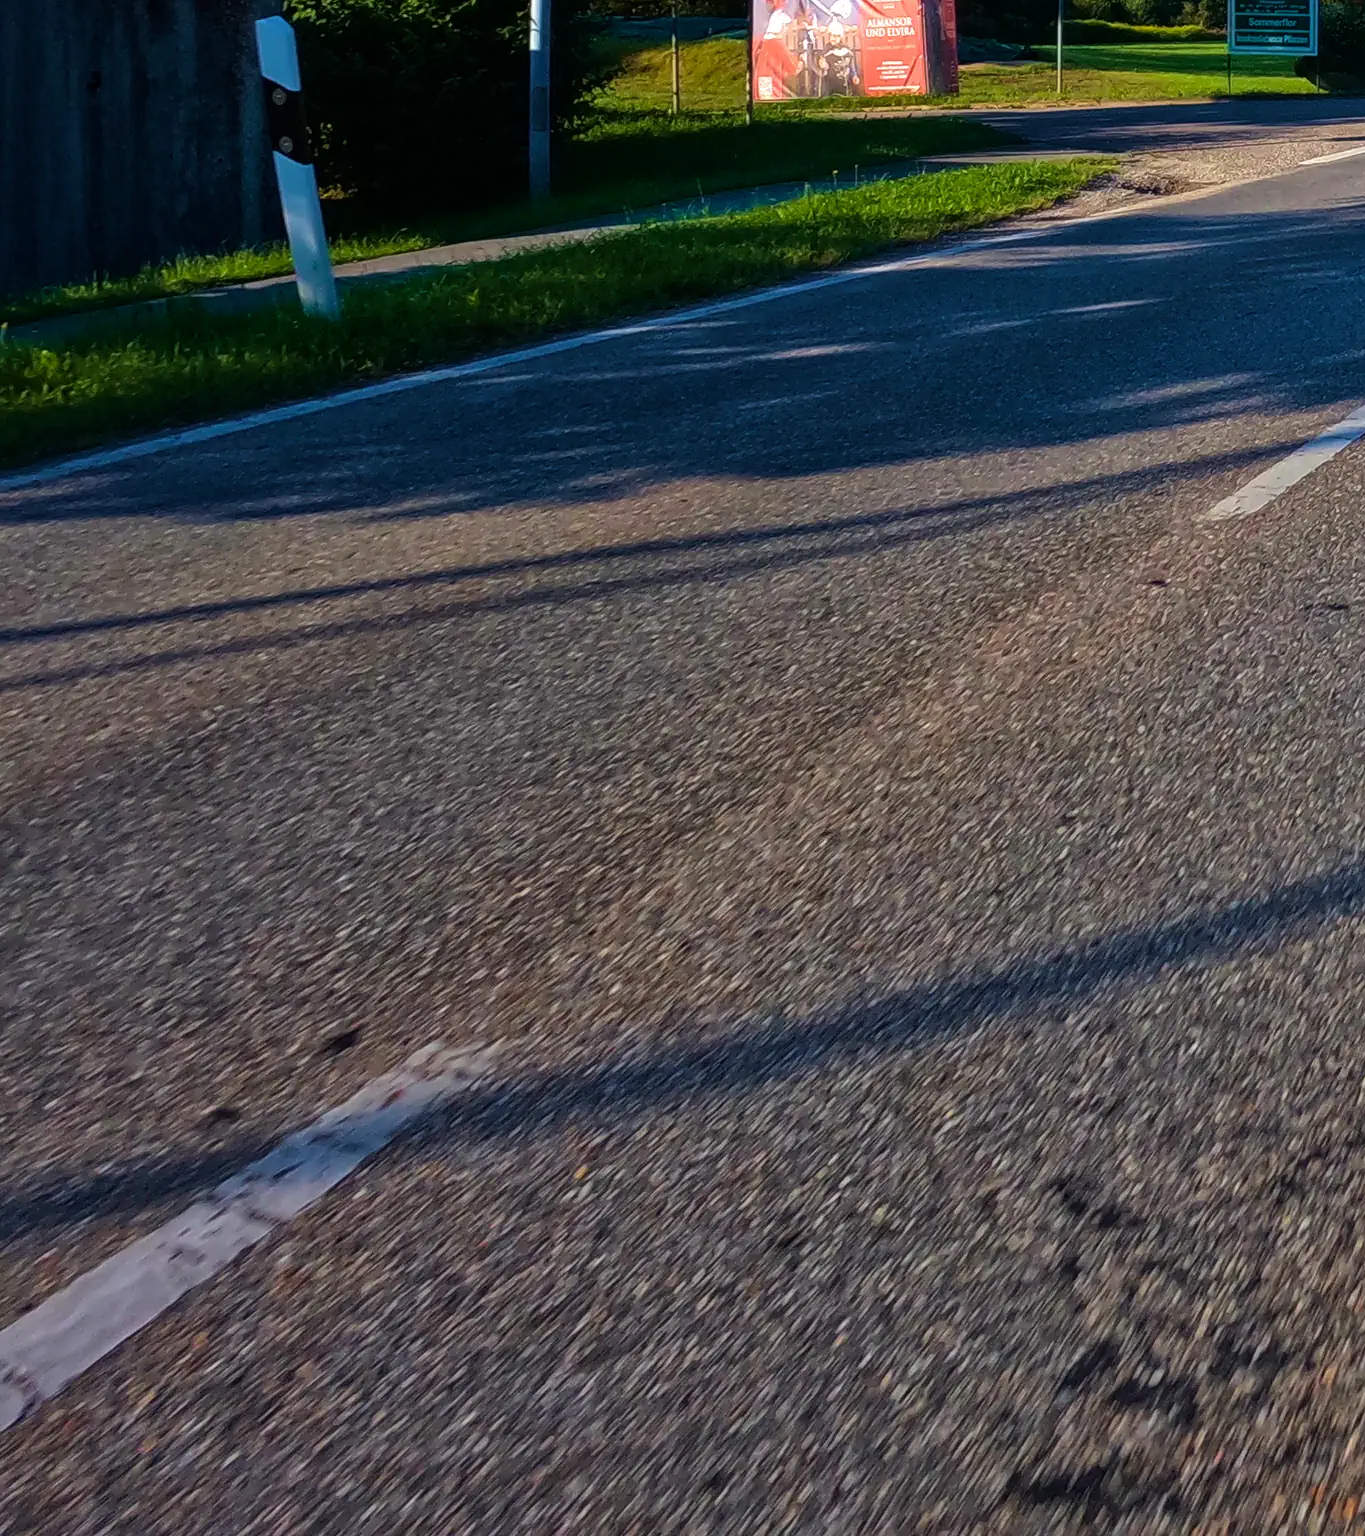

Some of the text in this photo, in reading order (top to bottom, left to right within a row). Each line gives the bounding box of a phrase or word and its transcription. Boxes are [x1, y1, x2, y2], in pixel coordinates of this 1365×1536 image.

[867, 17, 912, 27] ALMANSOR
[1248, 17, 1297, 27] Sommerflor
[866, 27, 915, 38] UND ELVIRA
